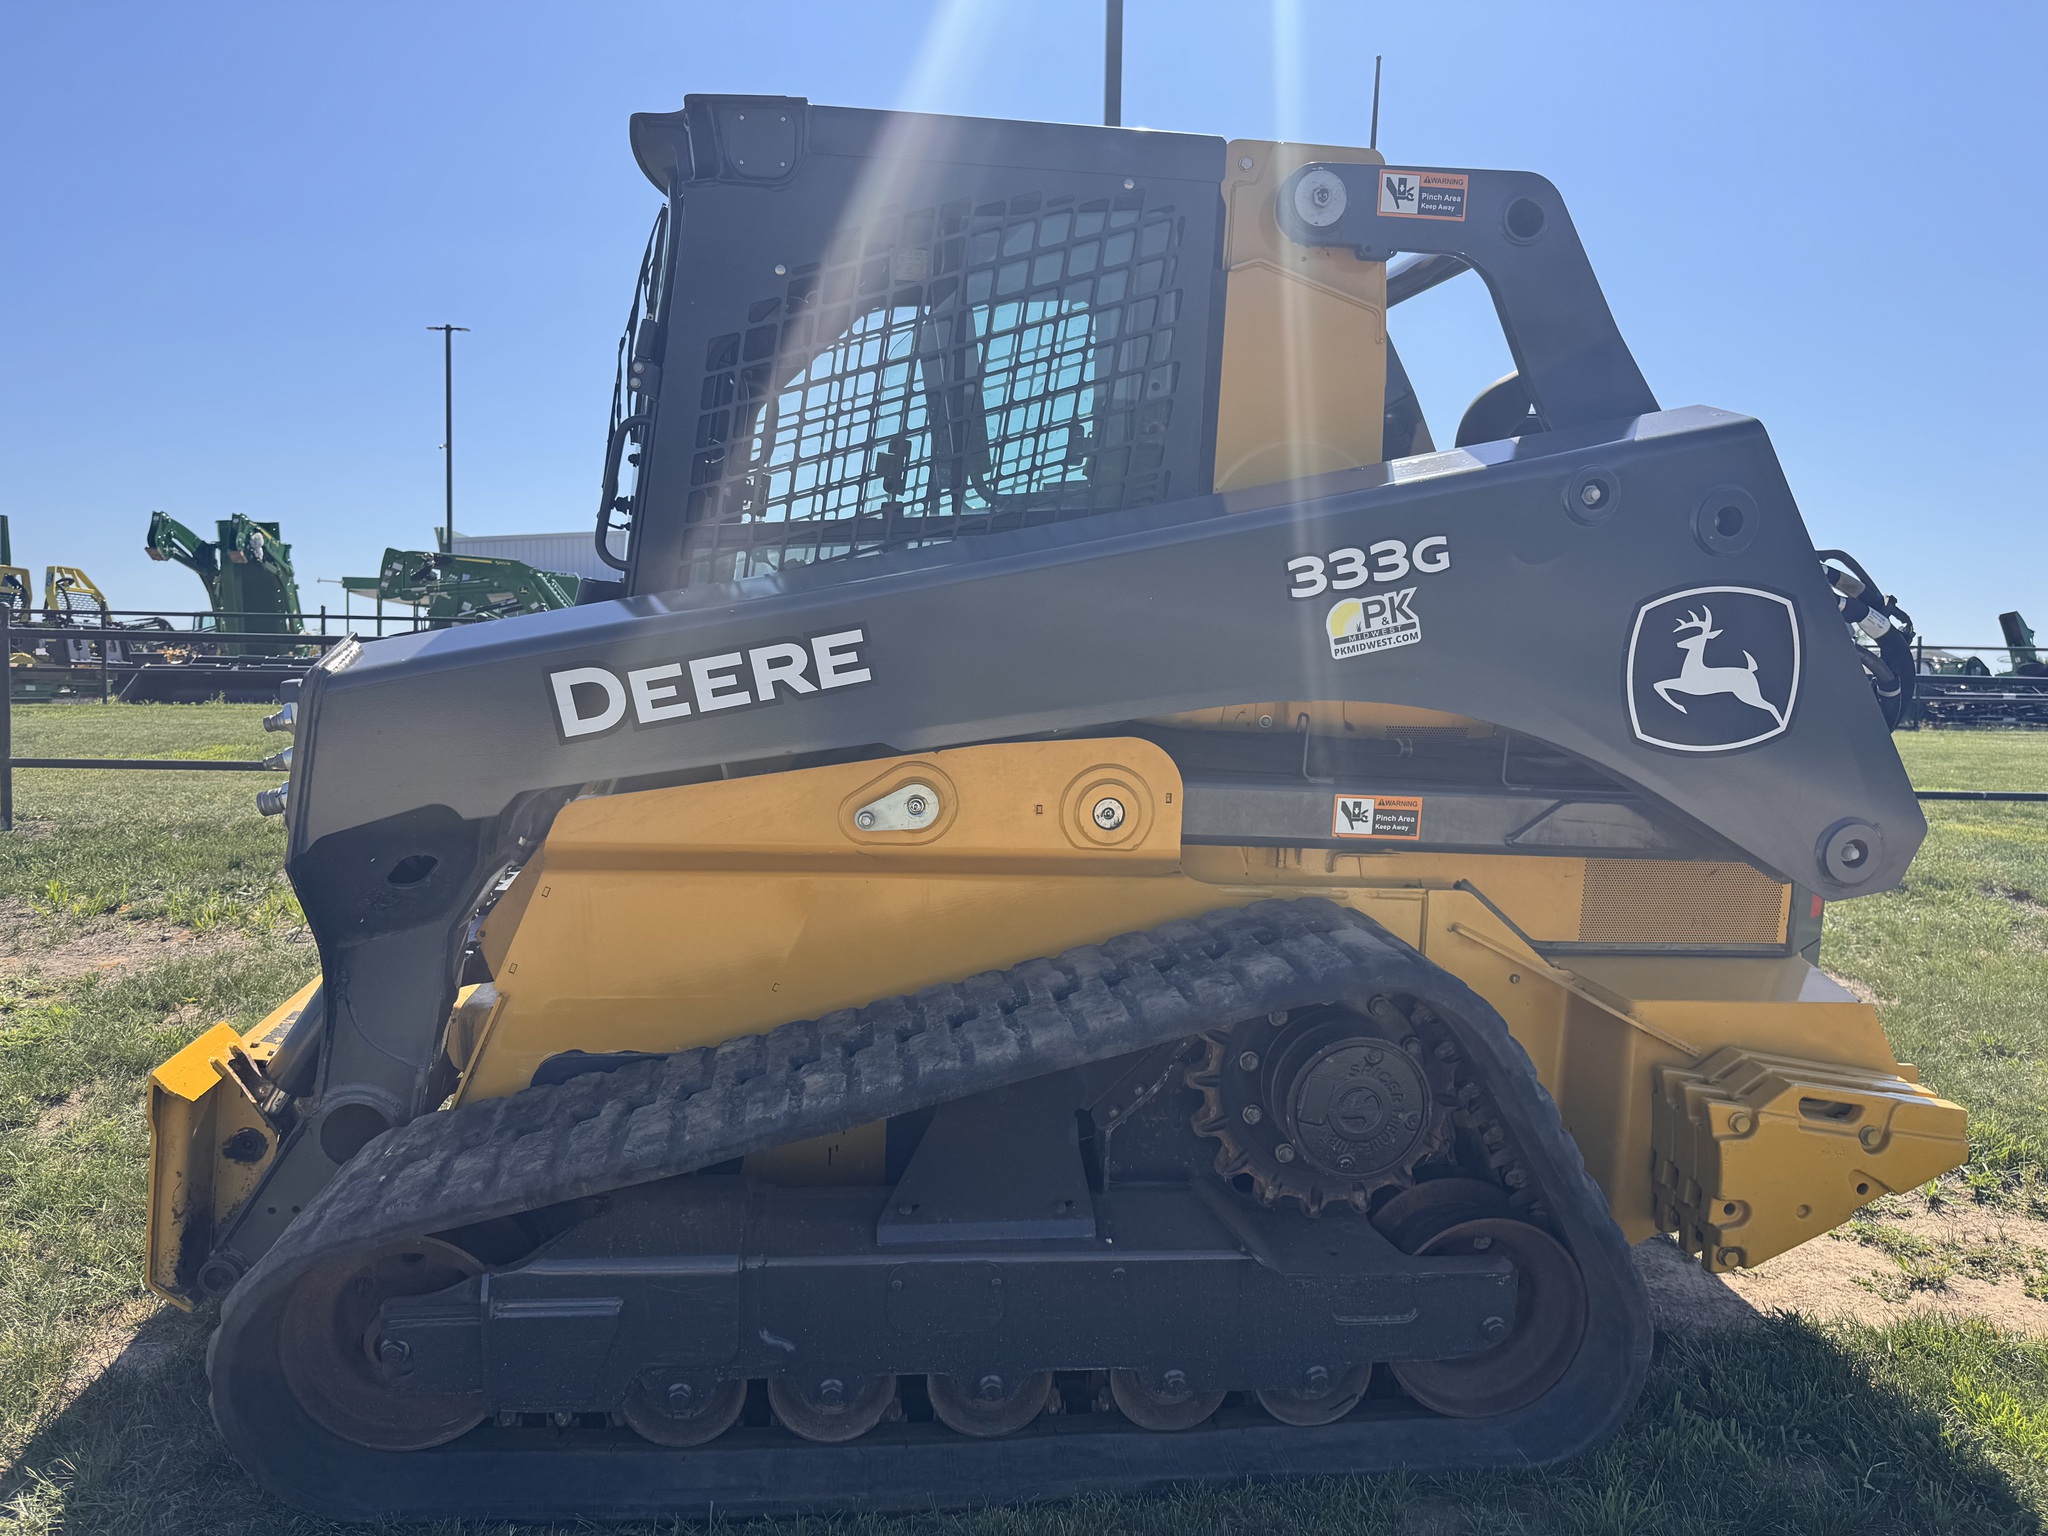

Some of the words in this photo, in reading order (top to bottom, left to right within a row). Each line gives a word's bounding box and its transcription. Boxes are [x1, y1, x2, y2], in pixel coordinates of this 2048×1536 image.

[1431, 177, 1463, 186] WARNING
[1421, 192, 1442, 201] Pinch
[1443, 194, 1461, 202] Area
[1420, 202, 1437, 211] Keep
[1438, 204, 1455, 212] Away
[1287, 535, 1450, 598] 333G
[1348, 626, 1402, 642] MIDWEST
[1334, 631, 1419, 657] PKMIDWEST.COM
[550, 629, 872, 737] DEERE
[1375, 814, 1397, 822] Pinch
[1397, 815, 1415, 823] Area
[1375, 823, 1391, 831] Keep
[1391, 824, 1409, 832] Away
[1349, 1064, 1404, 1103] SPICER
